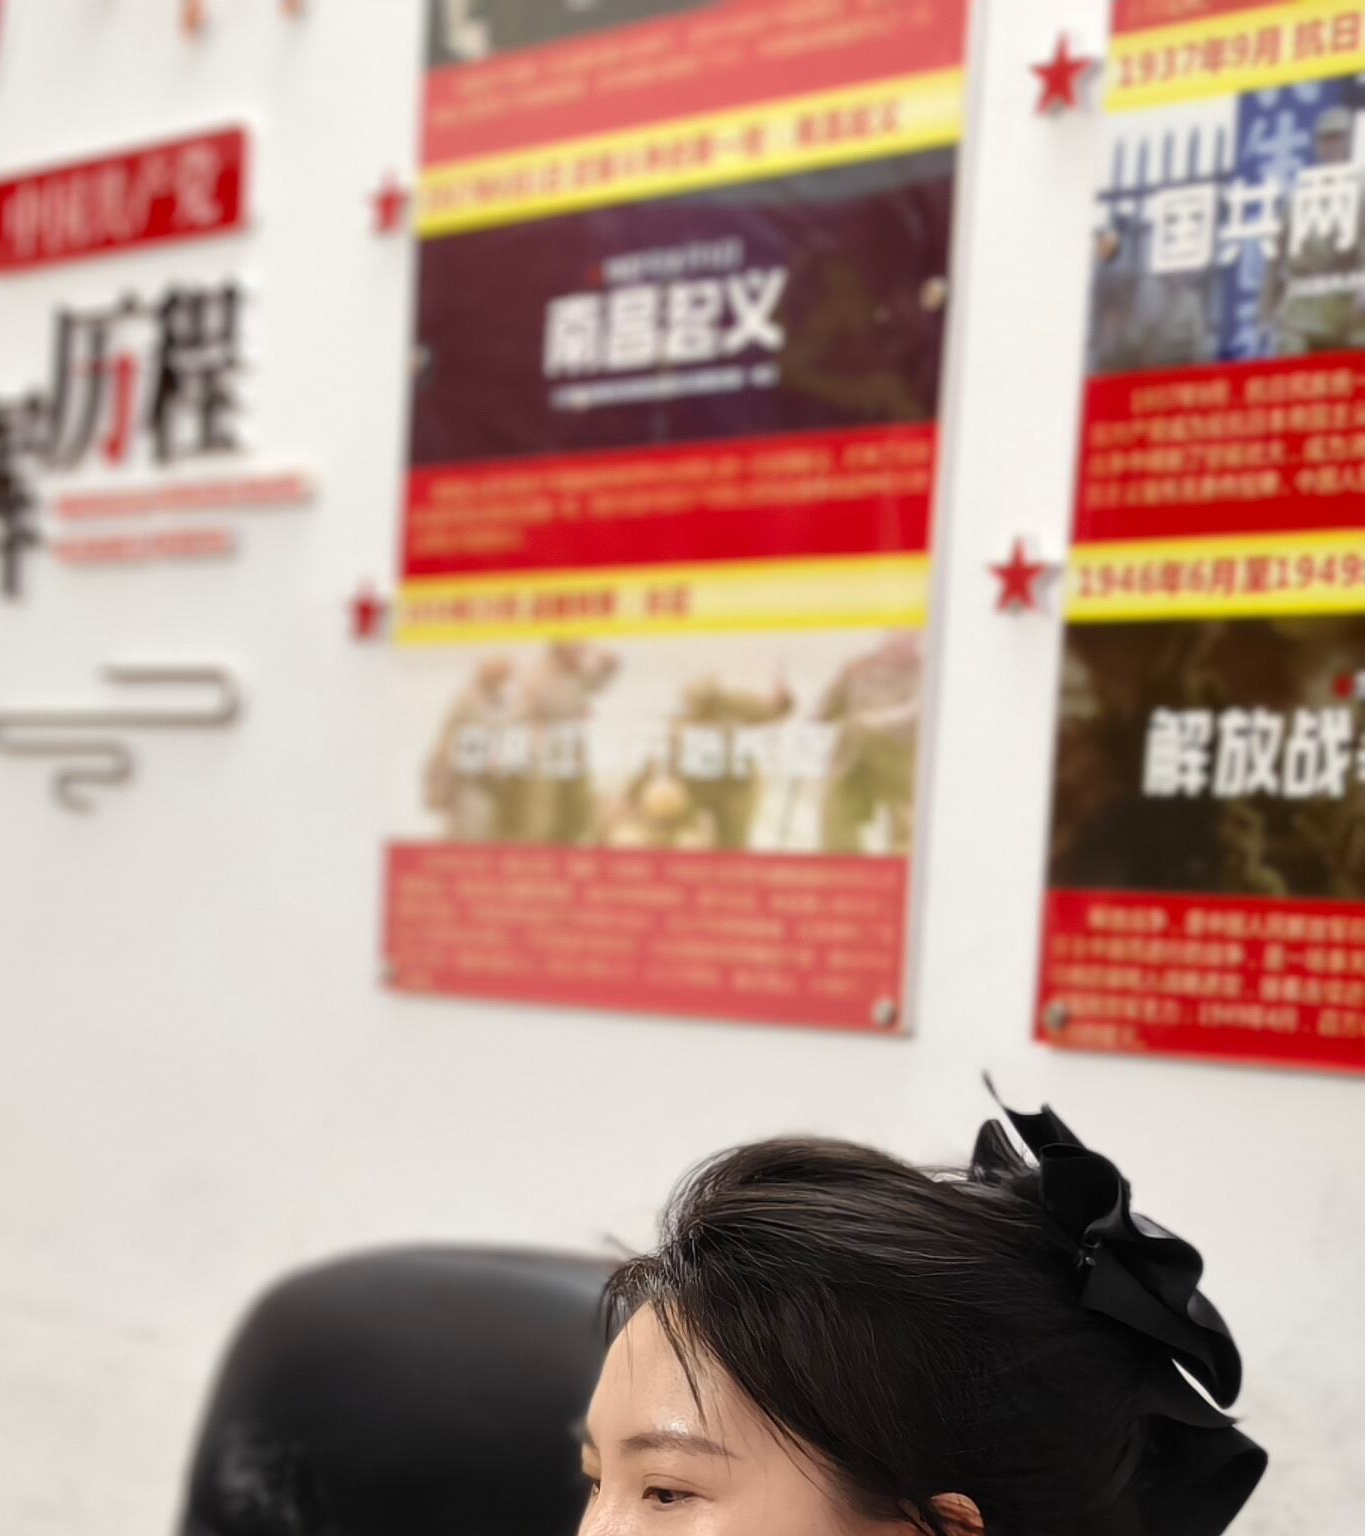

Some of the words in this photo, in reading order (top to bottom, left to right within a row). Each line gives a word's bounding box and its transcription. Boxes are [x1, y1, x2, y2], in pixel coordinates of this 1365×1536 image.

[1150, 164, 1361, 273] 国共两
[1078, 551, 1365, 600] 1946年6月至1949
[1143, 706, 1365, 799] 解放战
